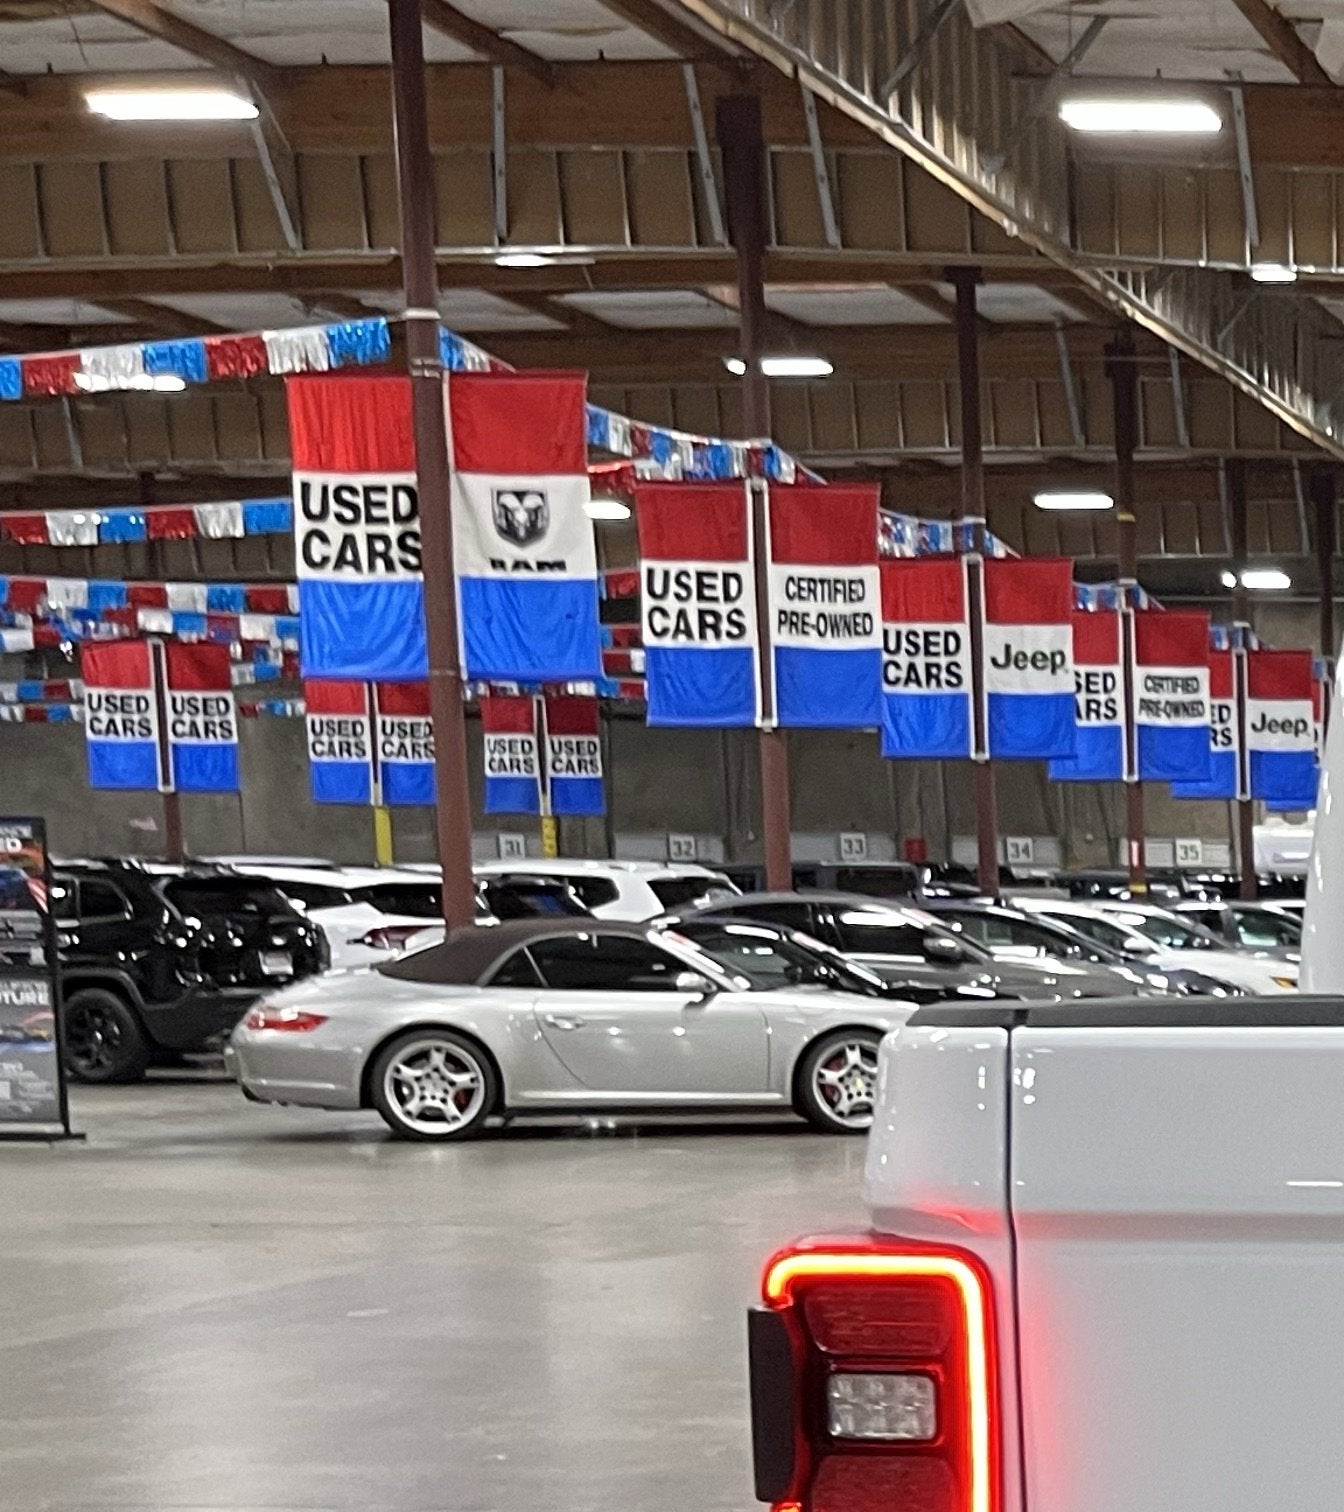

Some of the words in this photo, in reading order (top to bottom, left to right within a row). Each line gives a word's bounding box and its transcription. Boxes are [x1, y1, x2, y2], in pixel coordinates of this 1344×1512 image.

[300, 481, 418, 525] USED
[301, 528, 422, 574] CARS
[646, 568, 743, 604] USED
[785, 576, 866, 604] CERTIFIED
[647, 606, 747, 641] CARS
[777, 608, 874, 639] PRE-OWNED
[883, 629, 961, 658] USED
[990, 643, 1067, 676] Jeep
[883, 660, 963, 688] CARS
[1143, 674, 1200, 695] CERTIFIED
[87, 693, 150, 715] USED
[171, 695, 231, 717] USED
[1138, 698, 1206, 720] PRE-OWNED
[89, 716, 153, 738] CARS
[171, 719, 233, 740] CARS
[310, 719, 365, 738] USED
[381, 720, 433, 738] USED
[1251, 712, 1309, 737] Jeep
[311, 740, 367, 758] CARS
[381, 741, 435, 759] CARS
[487, 739, 534, 756] USED
[551, 739, 598, 756] USED
[488, 757, 535, 774] CARS
[551, 758, 600, 775] CARS
